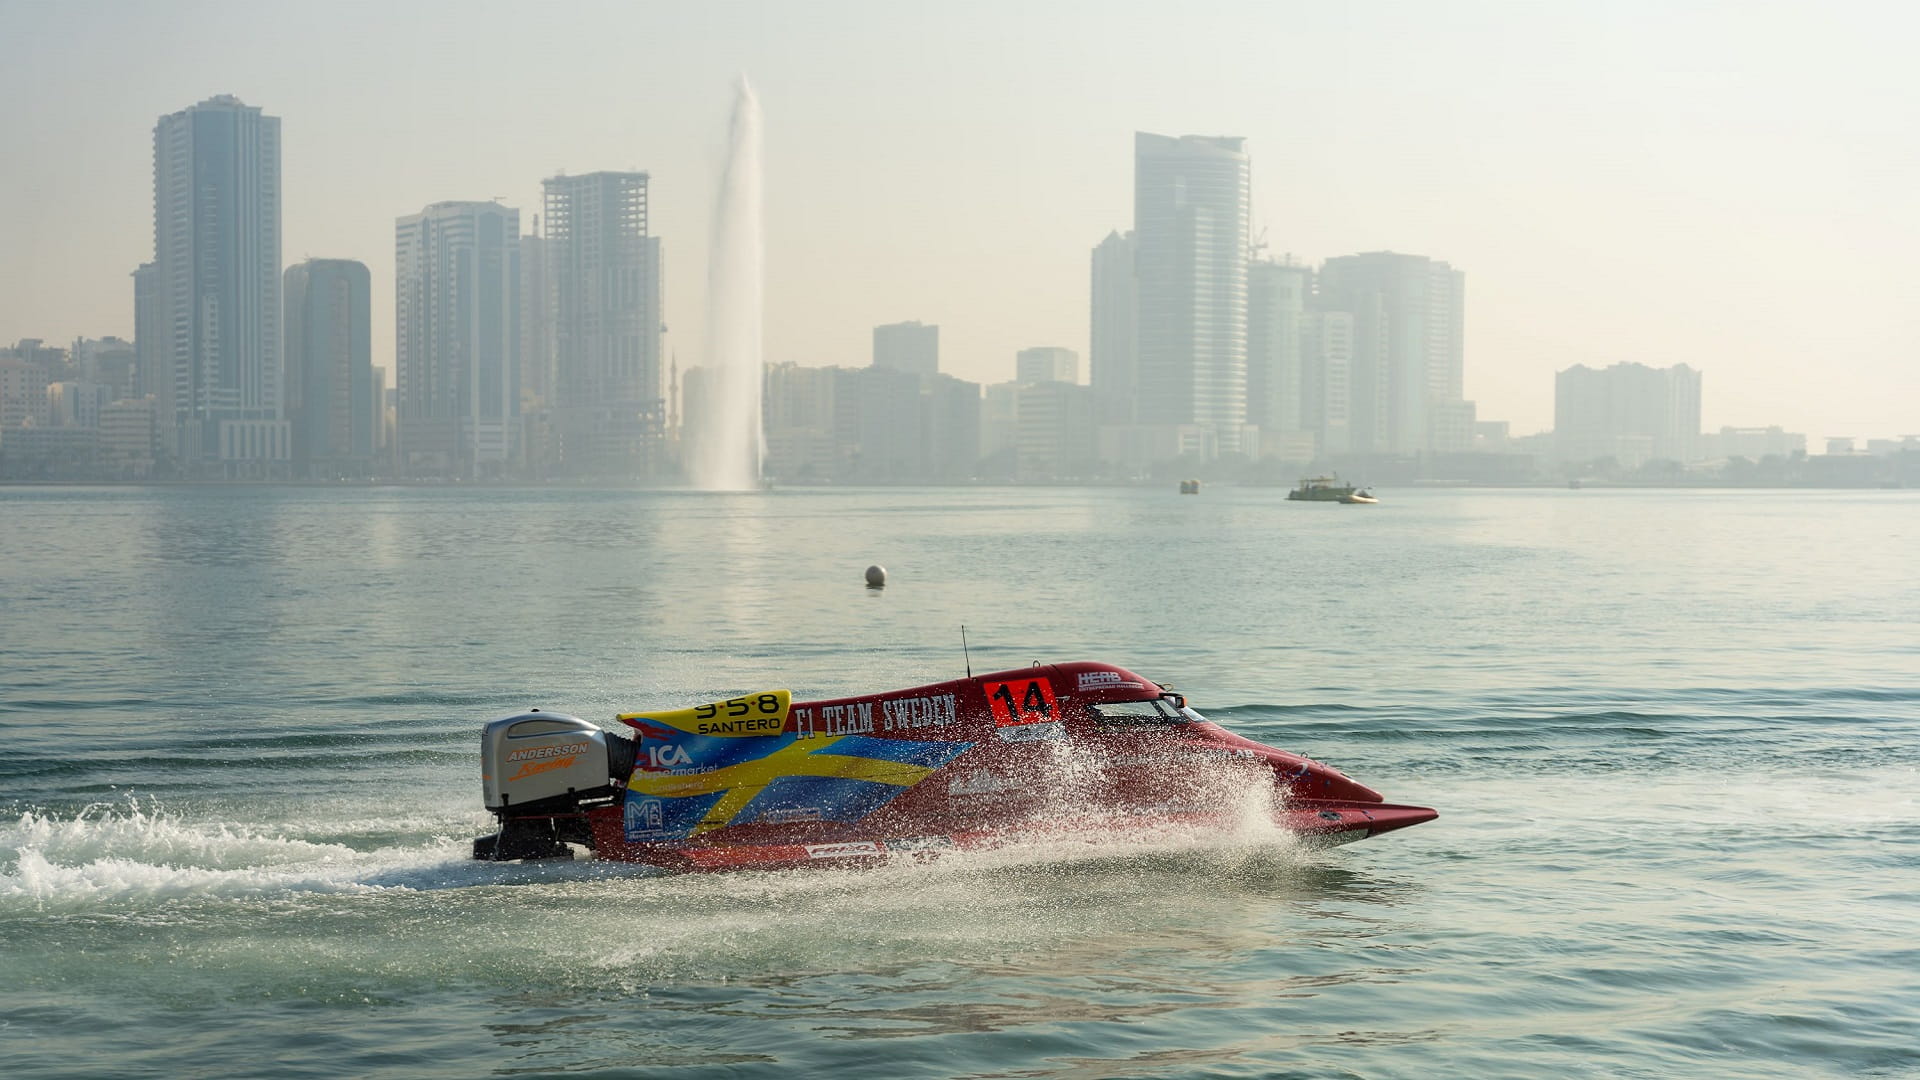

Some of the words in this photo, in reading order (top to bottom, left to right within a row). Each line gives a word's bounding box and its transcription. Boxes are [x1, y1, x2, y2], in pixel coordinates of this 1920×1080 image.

[994, 681, 1053, 722] 14
[698, 718, 781, 735] SANTERO
[795, 708, 815, 740] F1
[822, 702, 875, 737] TEAM
[882, 694, 957, 731] SWEDEN
[506, 742, 590, 762] ANDERSSON
[649, 744, 694, 768] ICA
[633, 762, 719, 782] Supermarket
